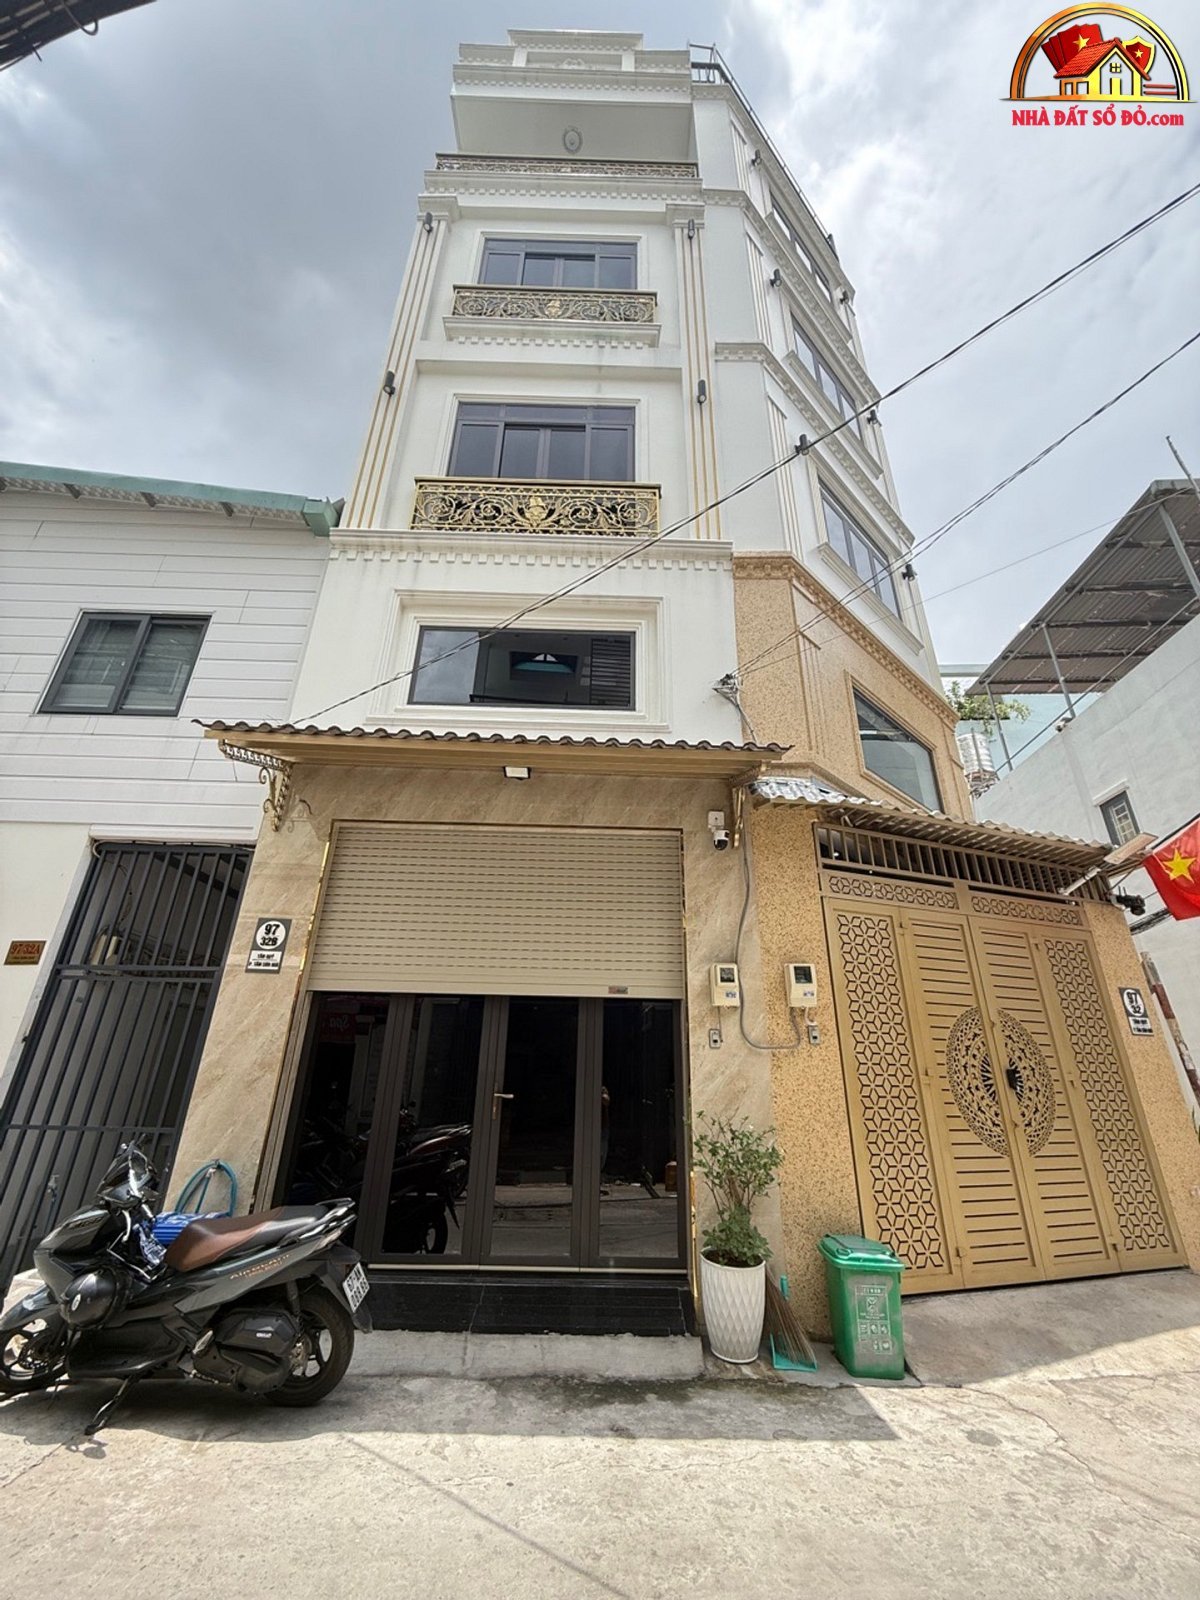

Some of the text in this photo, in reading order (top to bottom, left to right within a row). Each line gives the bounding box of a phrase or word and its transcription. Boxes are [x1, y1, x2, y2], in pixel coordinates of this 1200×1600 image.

[264, 923, 281, 935] 97
[1126, 991, 1138, 1004] 97
[1131, 1005, 1141, 1014] 32
